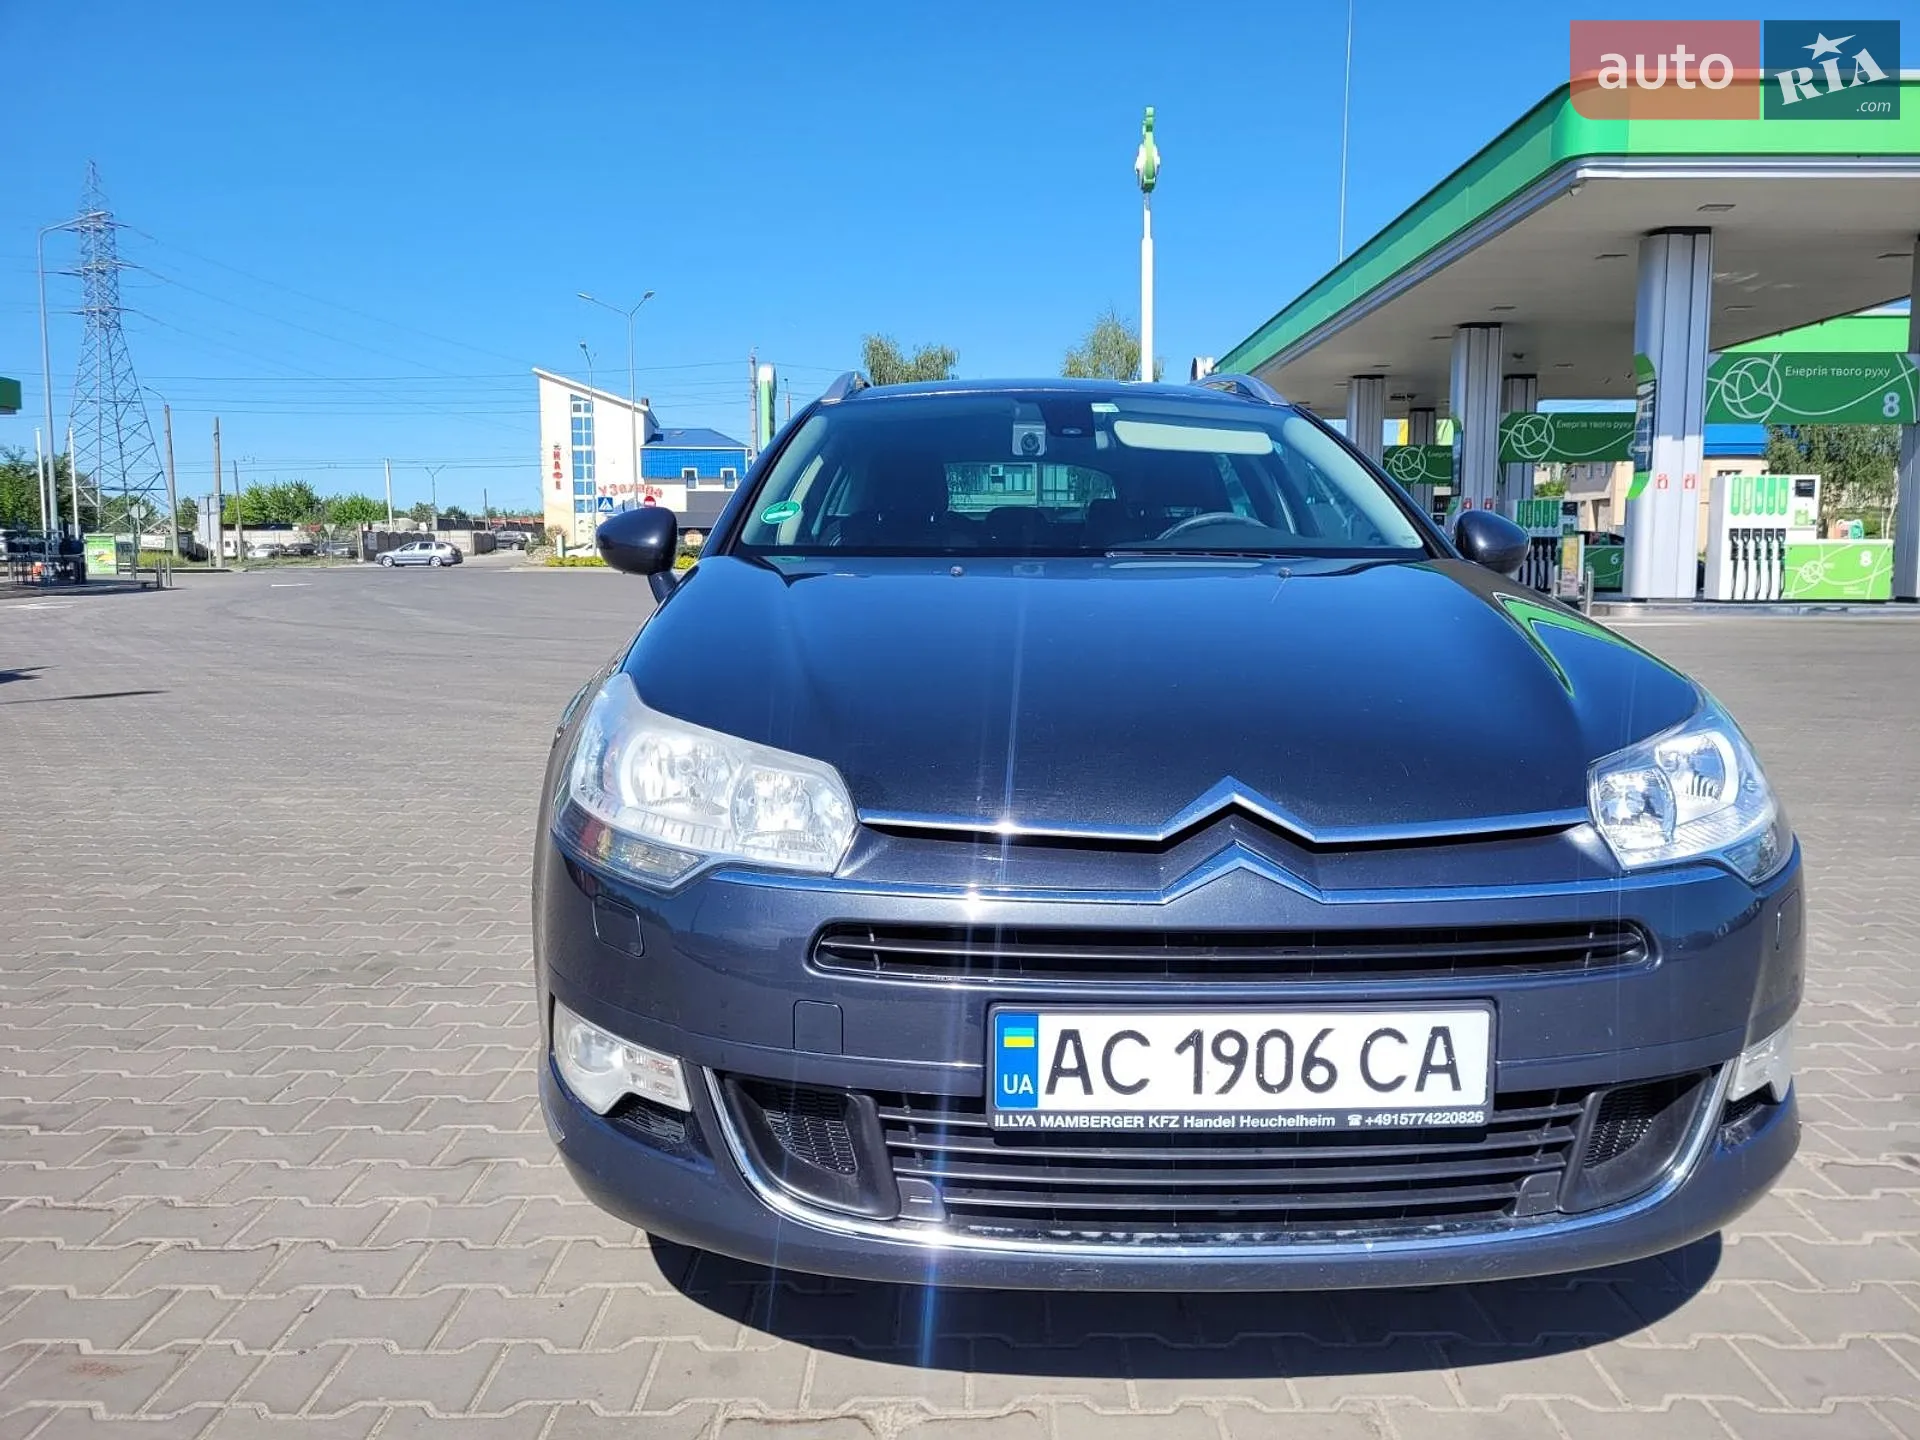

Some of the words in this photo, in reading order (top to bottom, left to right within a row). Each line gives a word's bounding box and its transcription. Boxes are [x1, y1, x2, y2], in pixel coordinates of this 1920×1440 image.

[1785, 366, 1828, 378] Енергія
[1831, 367, 1862, 377] твого
[1864, 367, 1891, 378] руху
[1882, 392, 1900, 417] 8
[1610, 553, 1619, 565] 6
[1860, 550, 1872, 567] 8
[1044, 1028, 1150, 1096] AC
[1174, 1027, 1338, 1096] 1906
[1360, 1025, 1462, 1093] CA
[1003, 1074, 1034, 1095] UA
[994, 1115, 1036, 1128] ILLYA
[1040, 1115, 1145, 1128] MAMBERGER
[1148, 1115, 1180, 1128] KFZ
[1183, 1115, 1235, 1128] Handel
[1240, 1114, 1336, 1128] Heuchelheim
